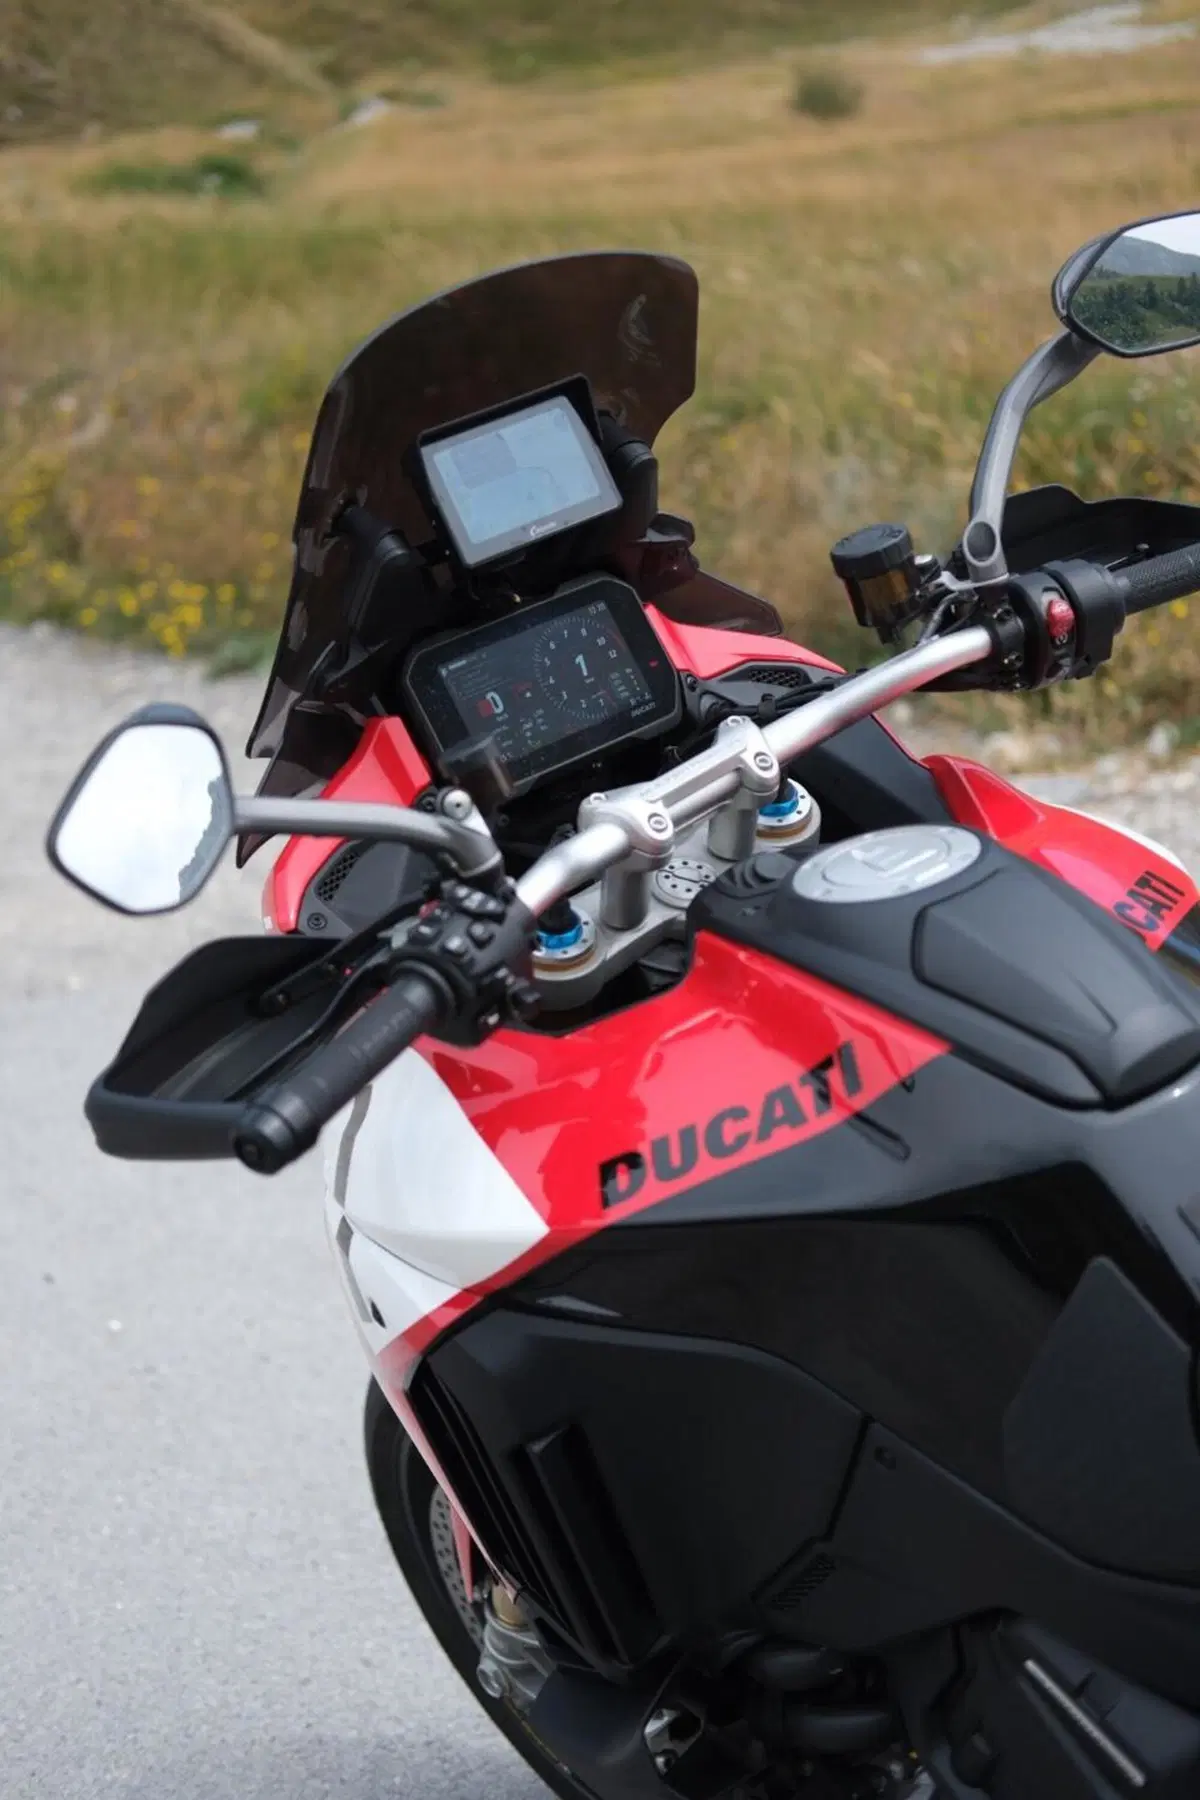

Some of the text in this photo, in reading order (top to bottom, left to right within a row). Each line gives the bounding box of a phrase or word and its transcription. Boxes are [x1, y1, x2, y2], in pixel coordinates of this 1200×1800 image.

[575, 653, 588, 677] 1
[580, 699, 587, 708] 2
[1112, 869, 1186, 932] CATI
[598, 1040, 864, 1210] DUCATI
